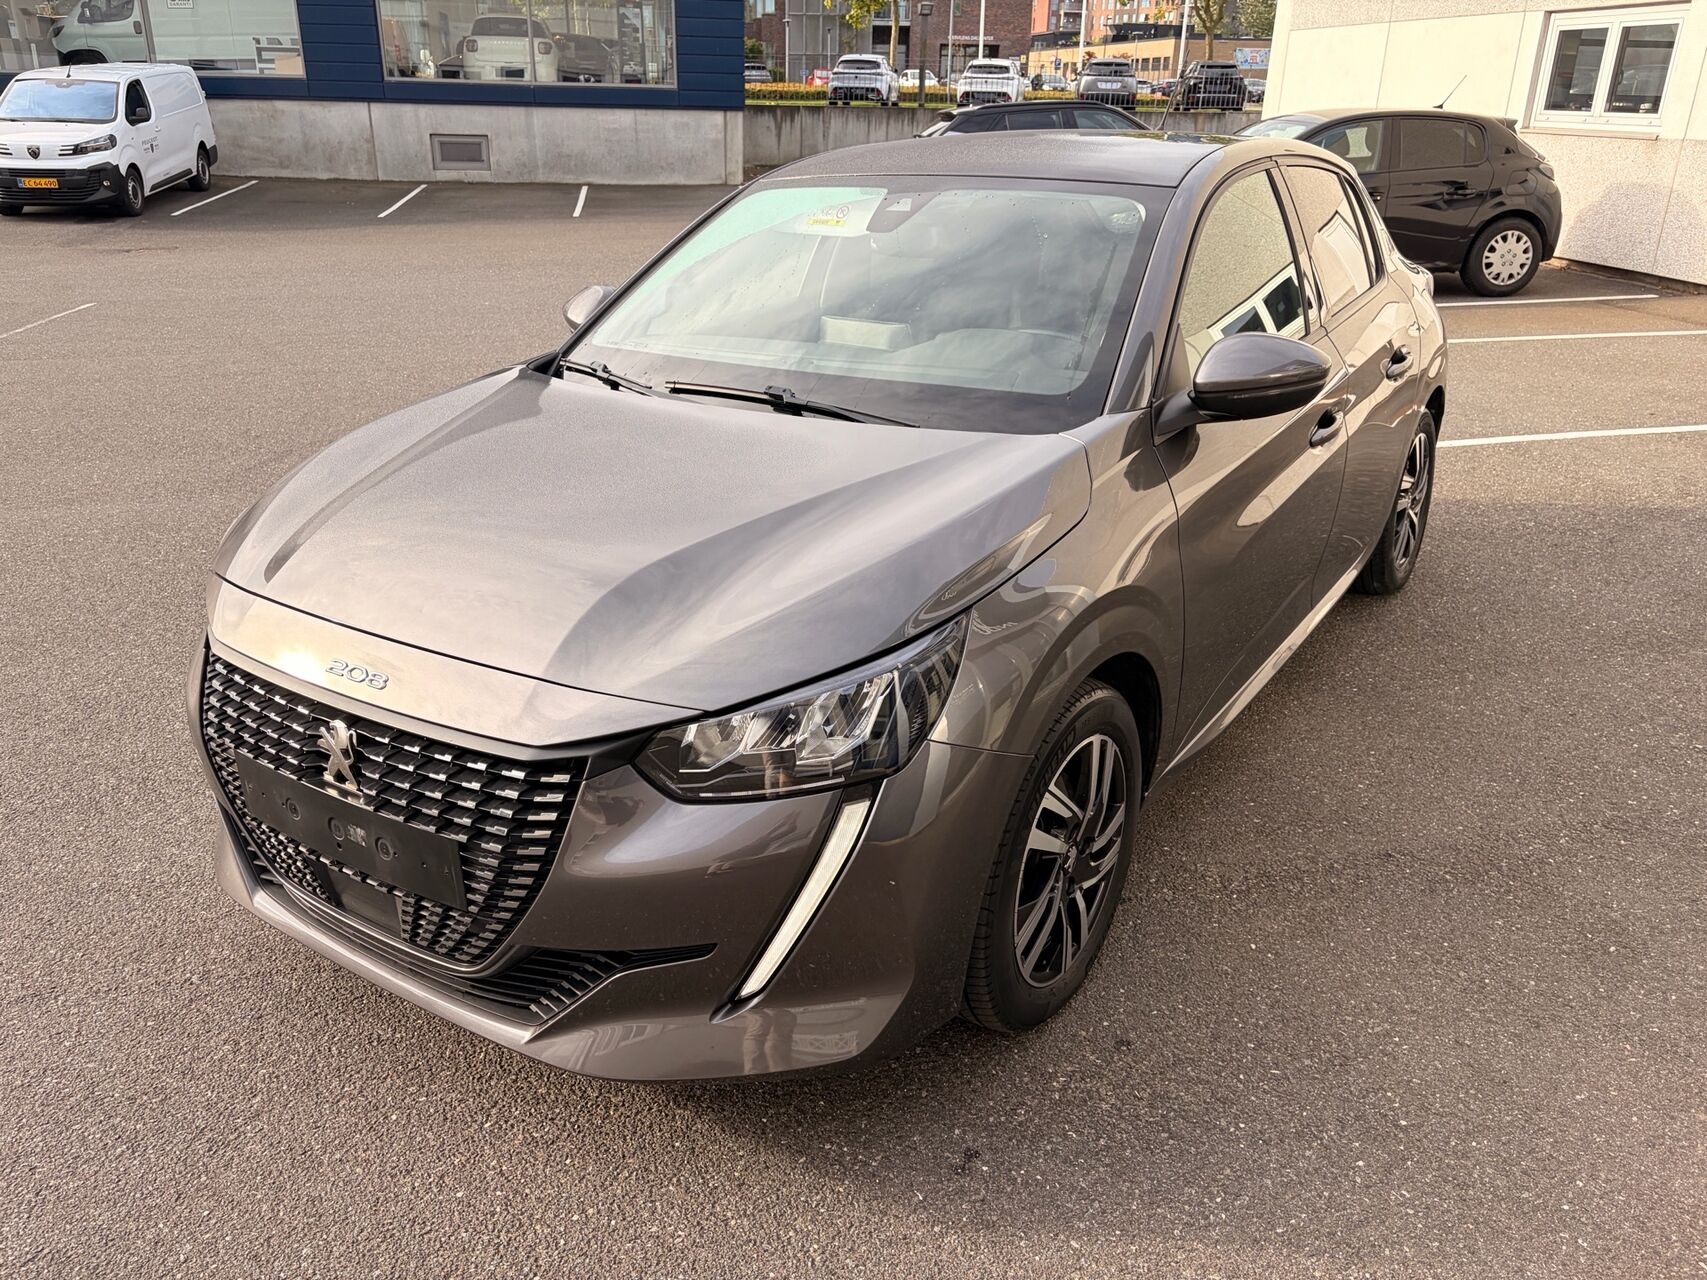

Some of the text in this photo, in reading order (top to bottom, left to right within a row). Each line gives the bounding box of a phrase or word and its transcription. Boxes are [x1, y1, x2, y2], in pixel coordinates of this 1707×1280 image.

[23, 179, 57, 188] EC 64 490
[325, 658, 390, 690] 208
